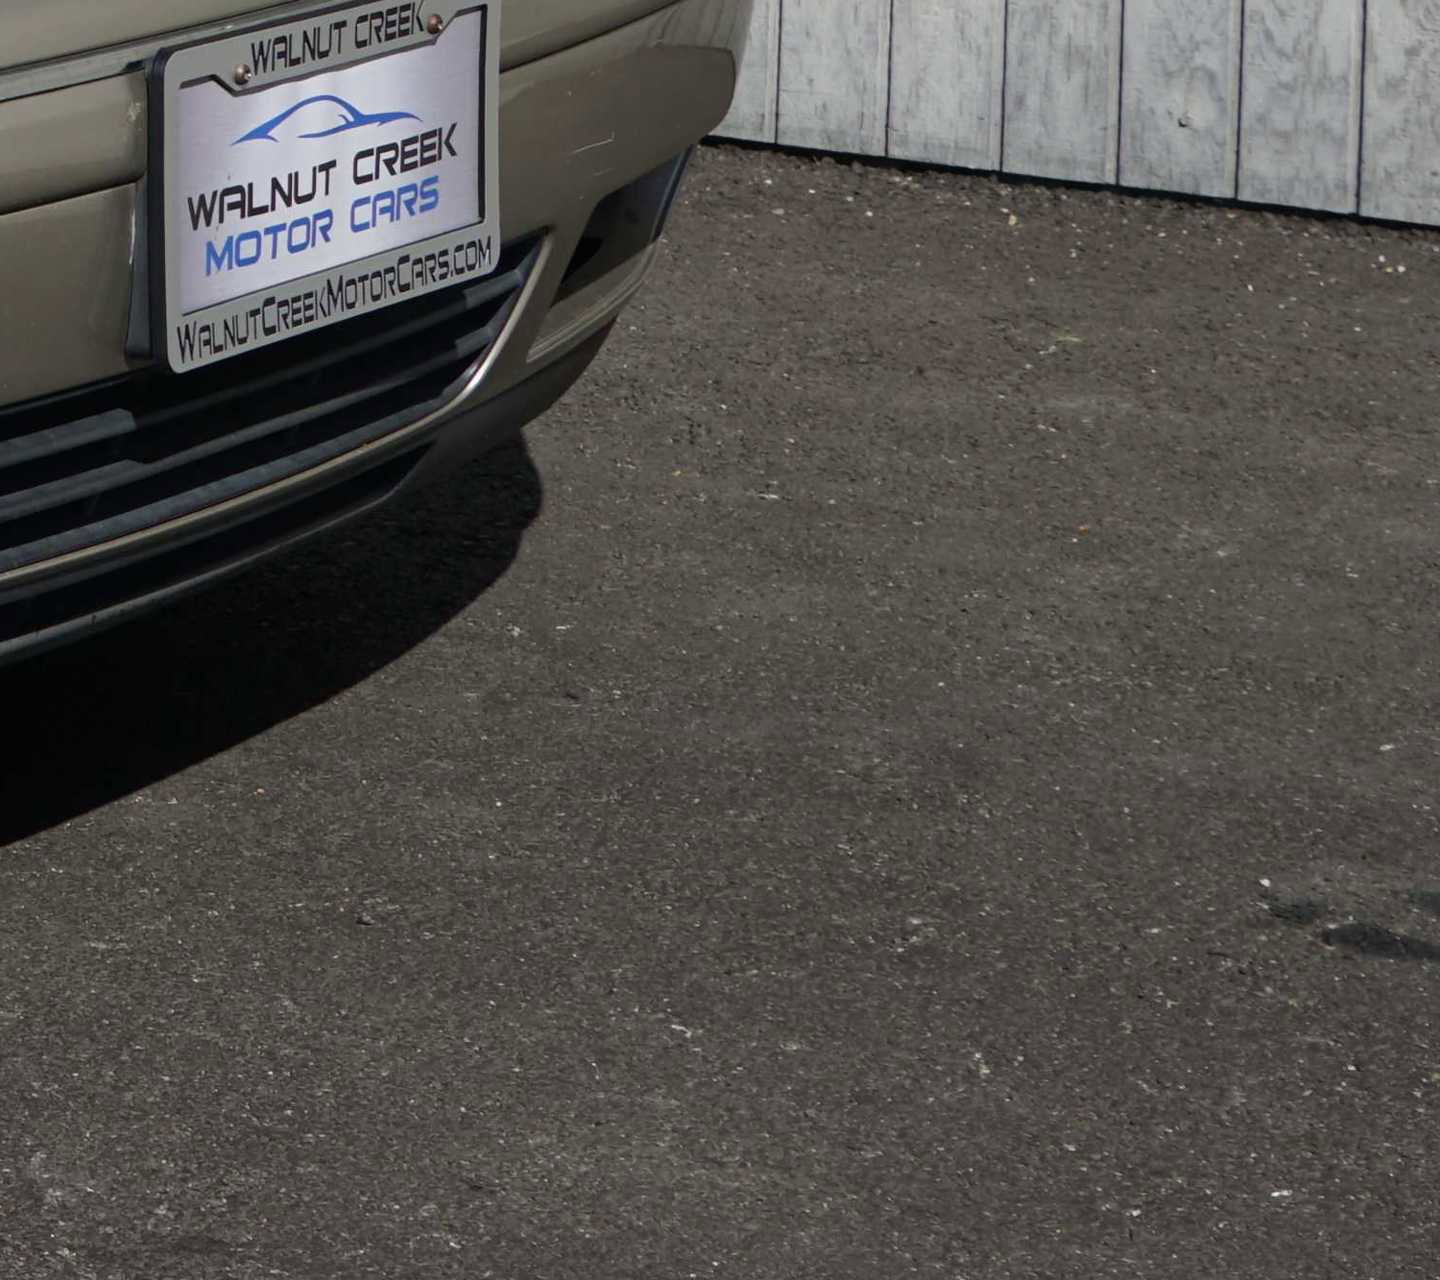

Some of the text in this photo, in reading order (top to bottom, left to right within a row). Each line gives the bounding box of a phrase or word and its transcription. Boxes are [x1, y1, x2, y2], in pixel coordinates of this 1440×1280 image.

[250, 0, 425, 77] WALNUT CREEK
[187, 122, 458, 231] WALNUT CREEK
[205, 175, 440, 278] MOTOR CARS
